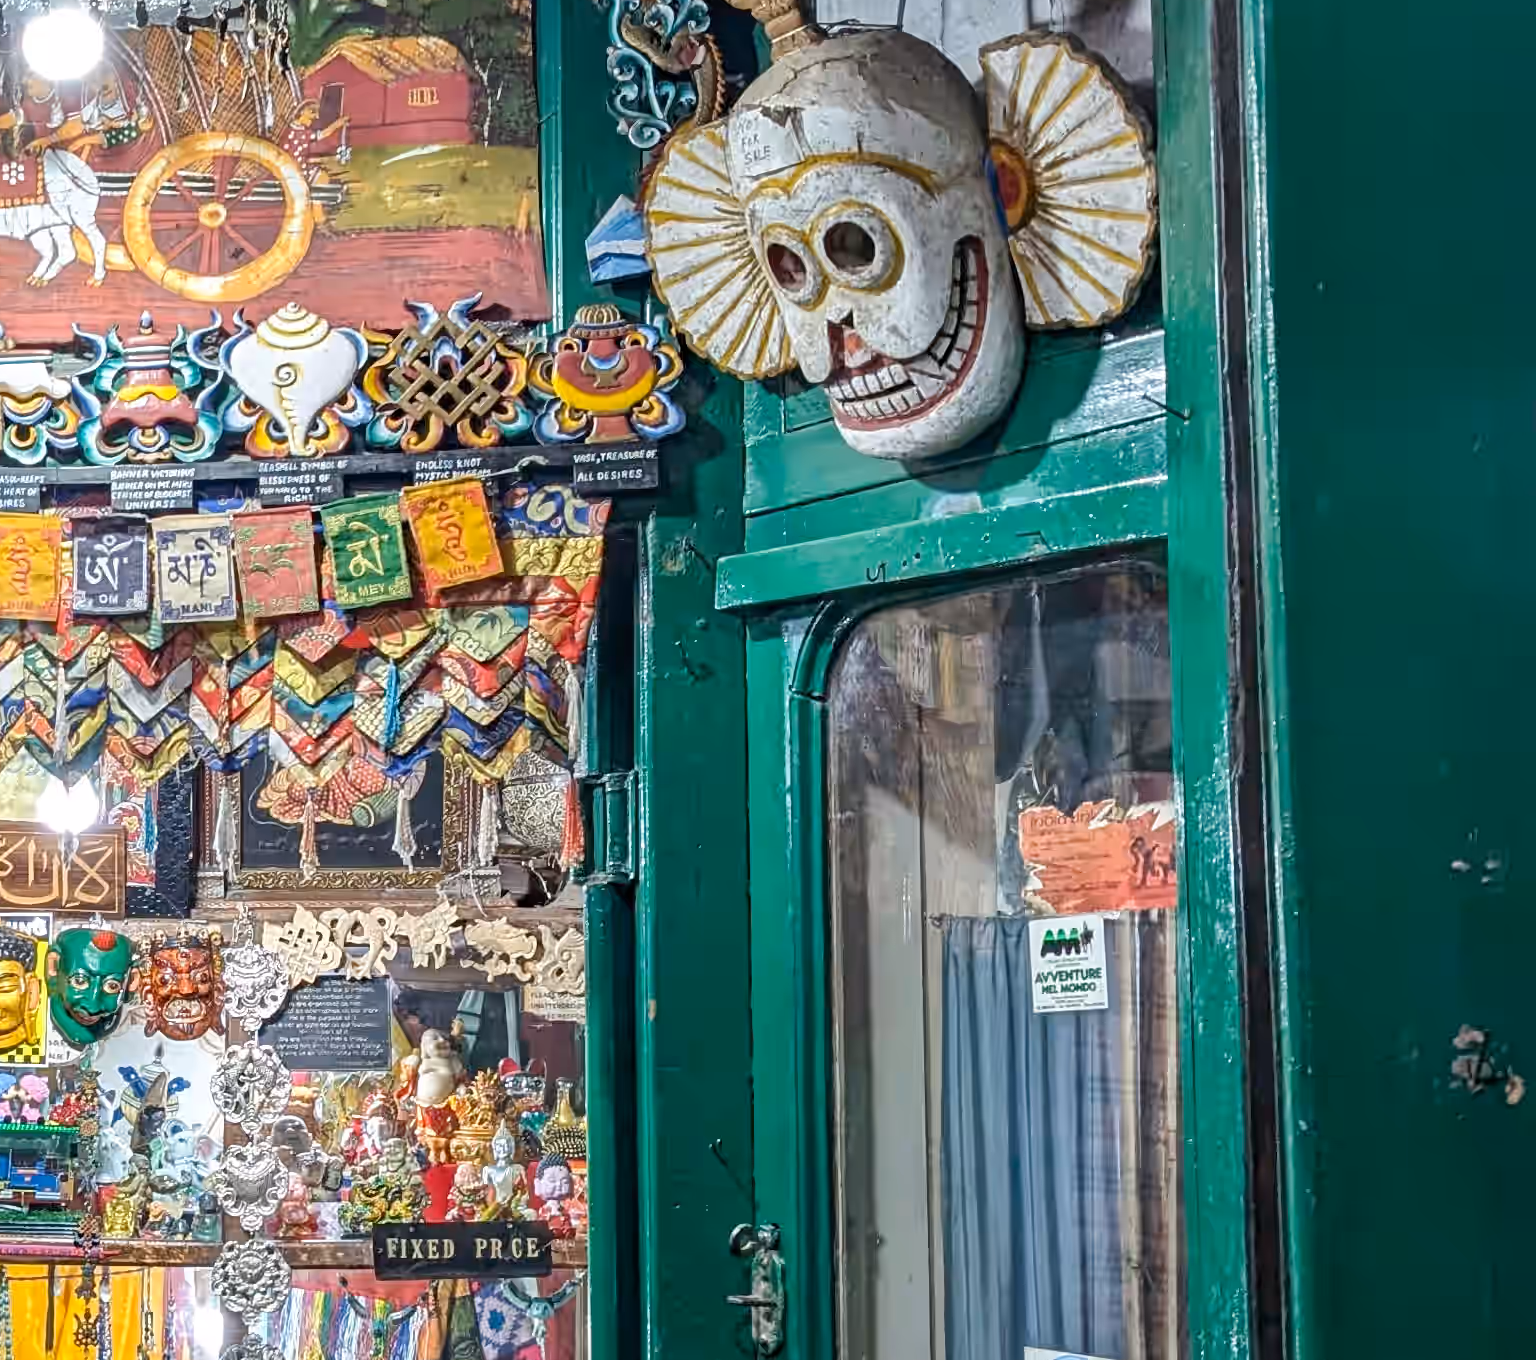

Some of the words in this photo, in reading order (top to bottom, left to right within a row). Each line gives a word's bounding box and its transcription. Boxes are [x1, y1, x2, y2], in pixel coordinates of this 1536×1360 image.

[415, 459, 454, 471] ENDLESS
[456, 457, 483, 469] KNOT
[111, 470, 149, 481] BANNER
[318, 473, 331, 483] OF
[415, 470, 452, 481] MYSTIC
[576, 471, 594, 483] ALL
[596, 468, 643, 481] DESIRES
[3, 487, 26, 497] HEAT
[298, 486, 311, 494] TO
[124, 499, 176, 510] UNIVERSE
[358, 583, 385, 597] MEY
[98, 594, 119, 605] OM
[181, 603, 214, 615] MANI
[1034, 967, 1103, 985] AVVENTURE
[1060, 982, 1097, 993] MONDO
[386, 1237, 456, 1260] FIXED
